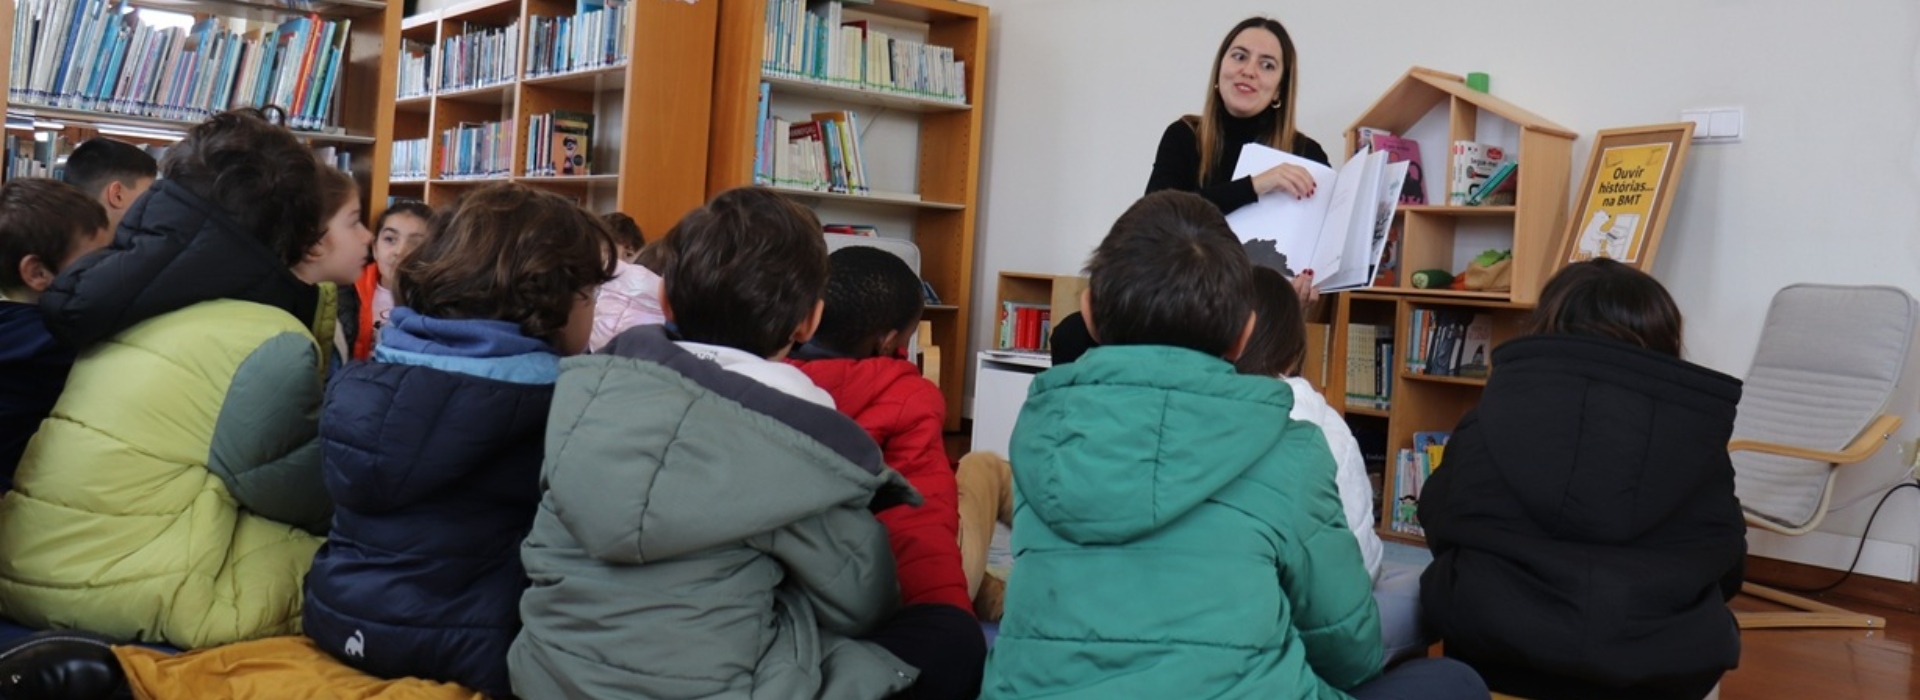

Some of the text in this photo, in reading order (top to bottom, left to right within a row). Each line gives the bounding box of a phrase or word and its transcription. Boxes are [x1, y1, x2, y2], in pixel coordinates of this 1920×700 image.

[1613, 165, 1645, 179] Ouvir
[1598, 180, 1654, 194] histórias...
[1602, 194, 1642, 207] na BMT
